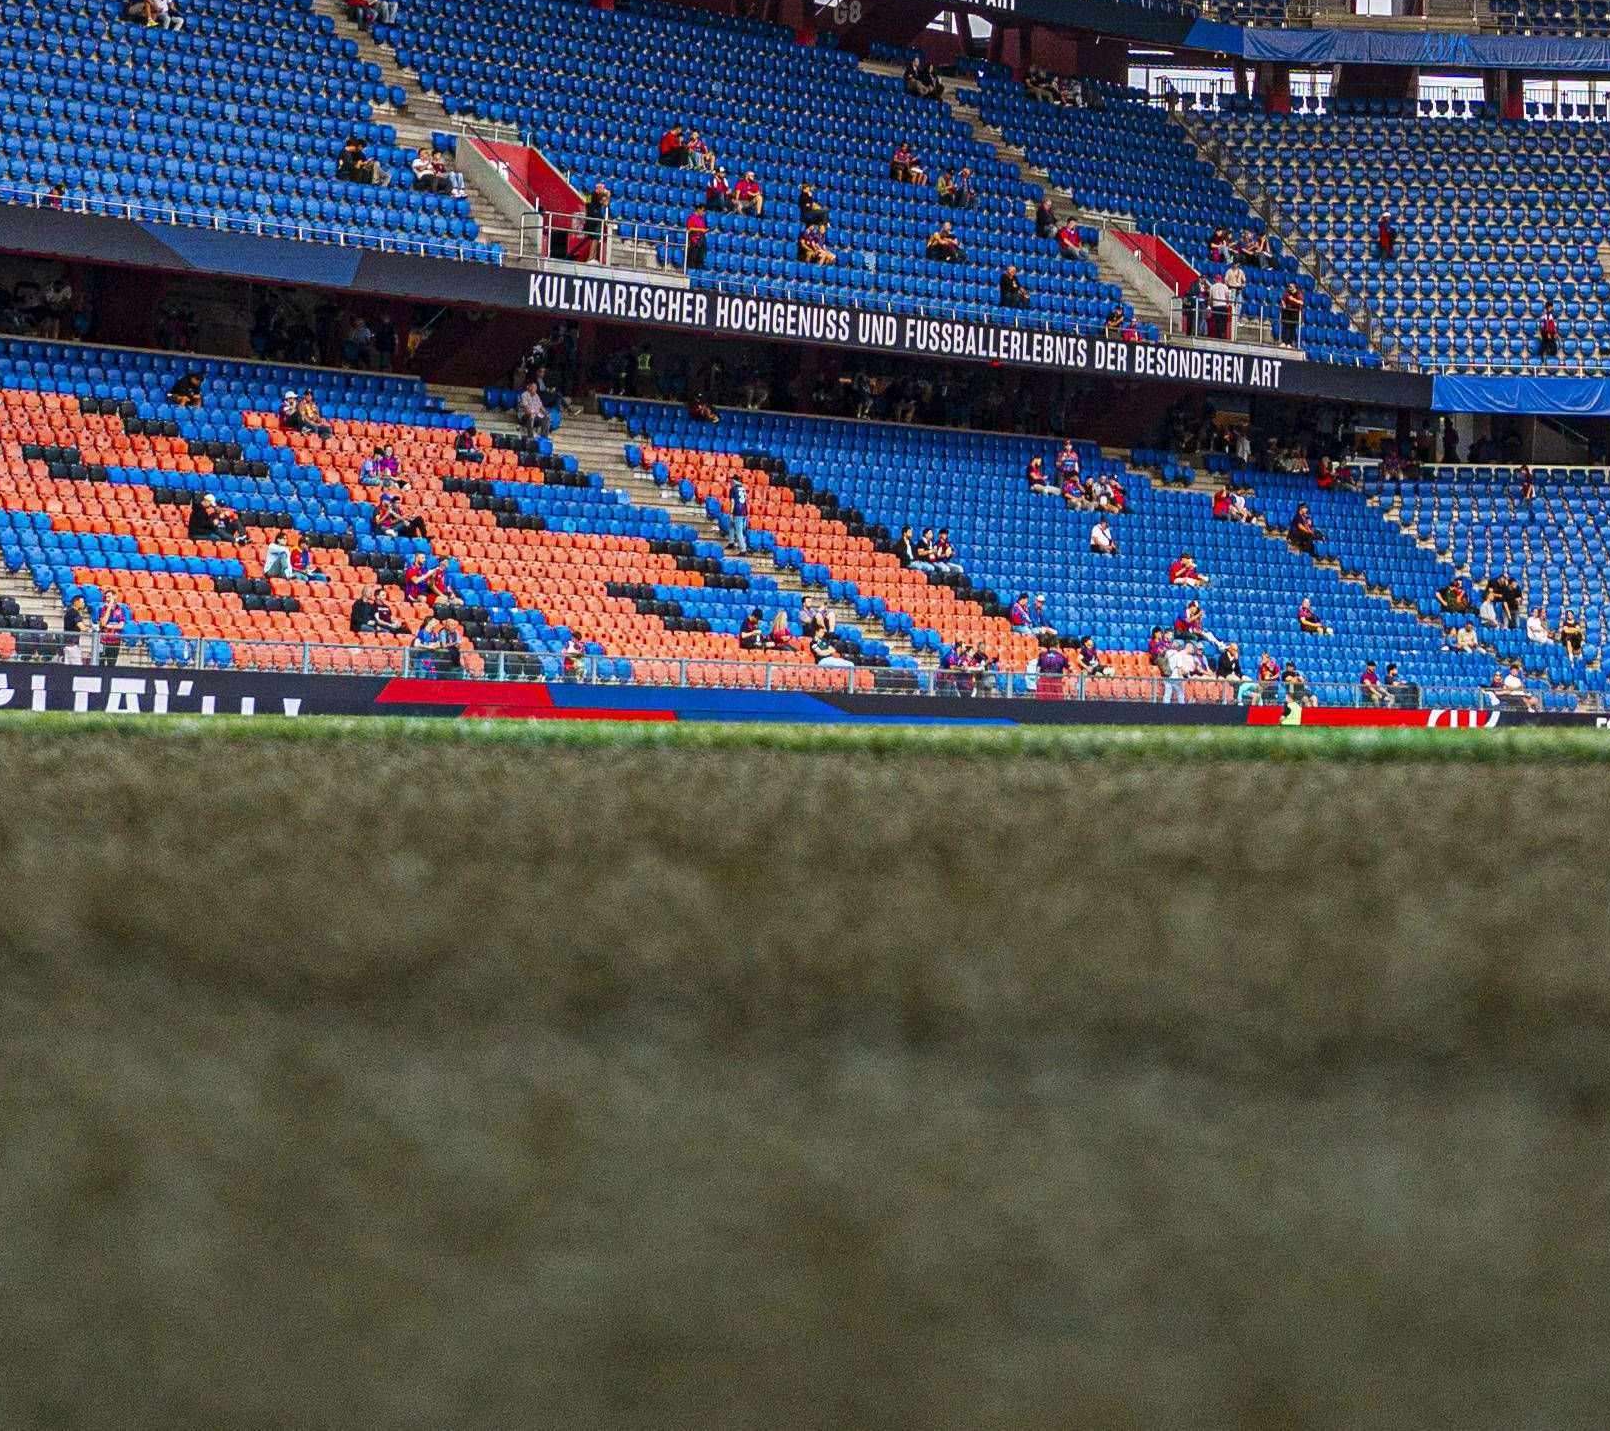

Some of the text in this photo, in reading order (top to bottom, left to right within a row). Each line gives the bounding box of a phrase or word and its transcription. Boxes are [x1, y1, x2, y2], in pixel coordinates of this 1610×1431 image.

[527, 272, 1282, 389] KULINARISCHER HOCHGENUSS UND FUSSBALLERLEBNIS DER BESONDEREN ART
